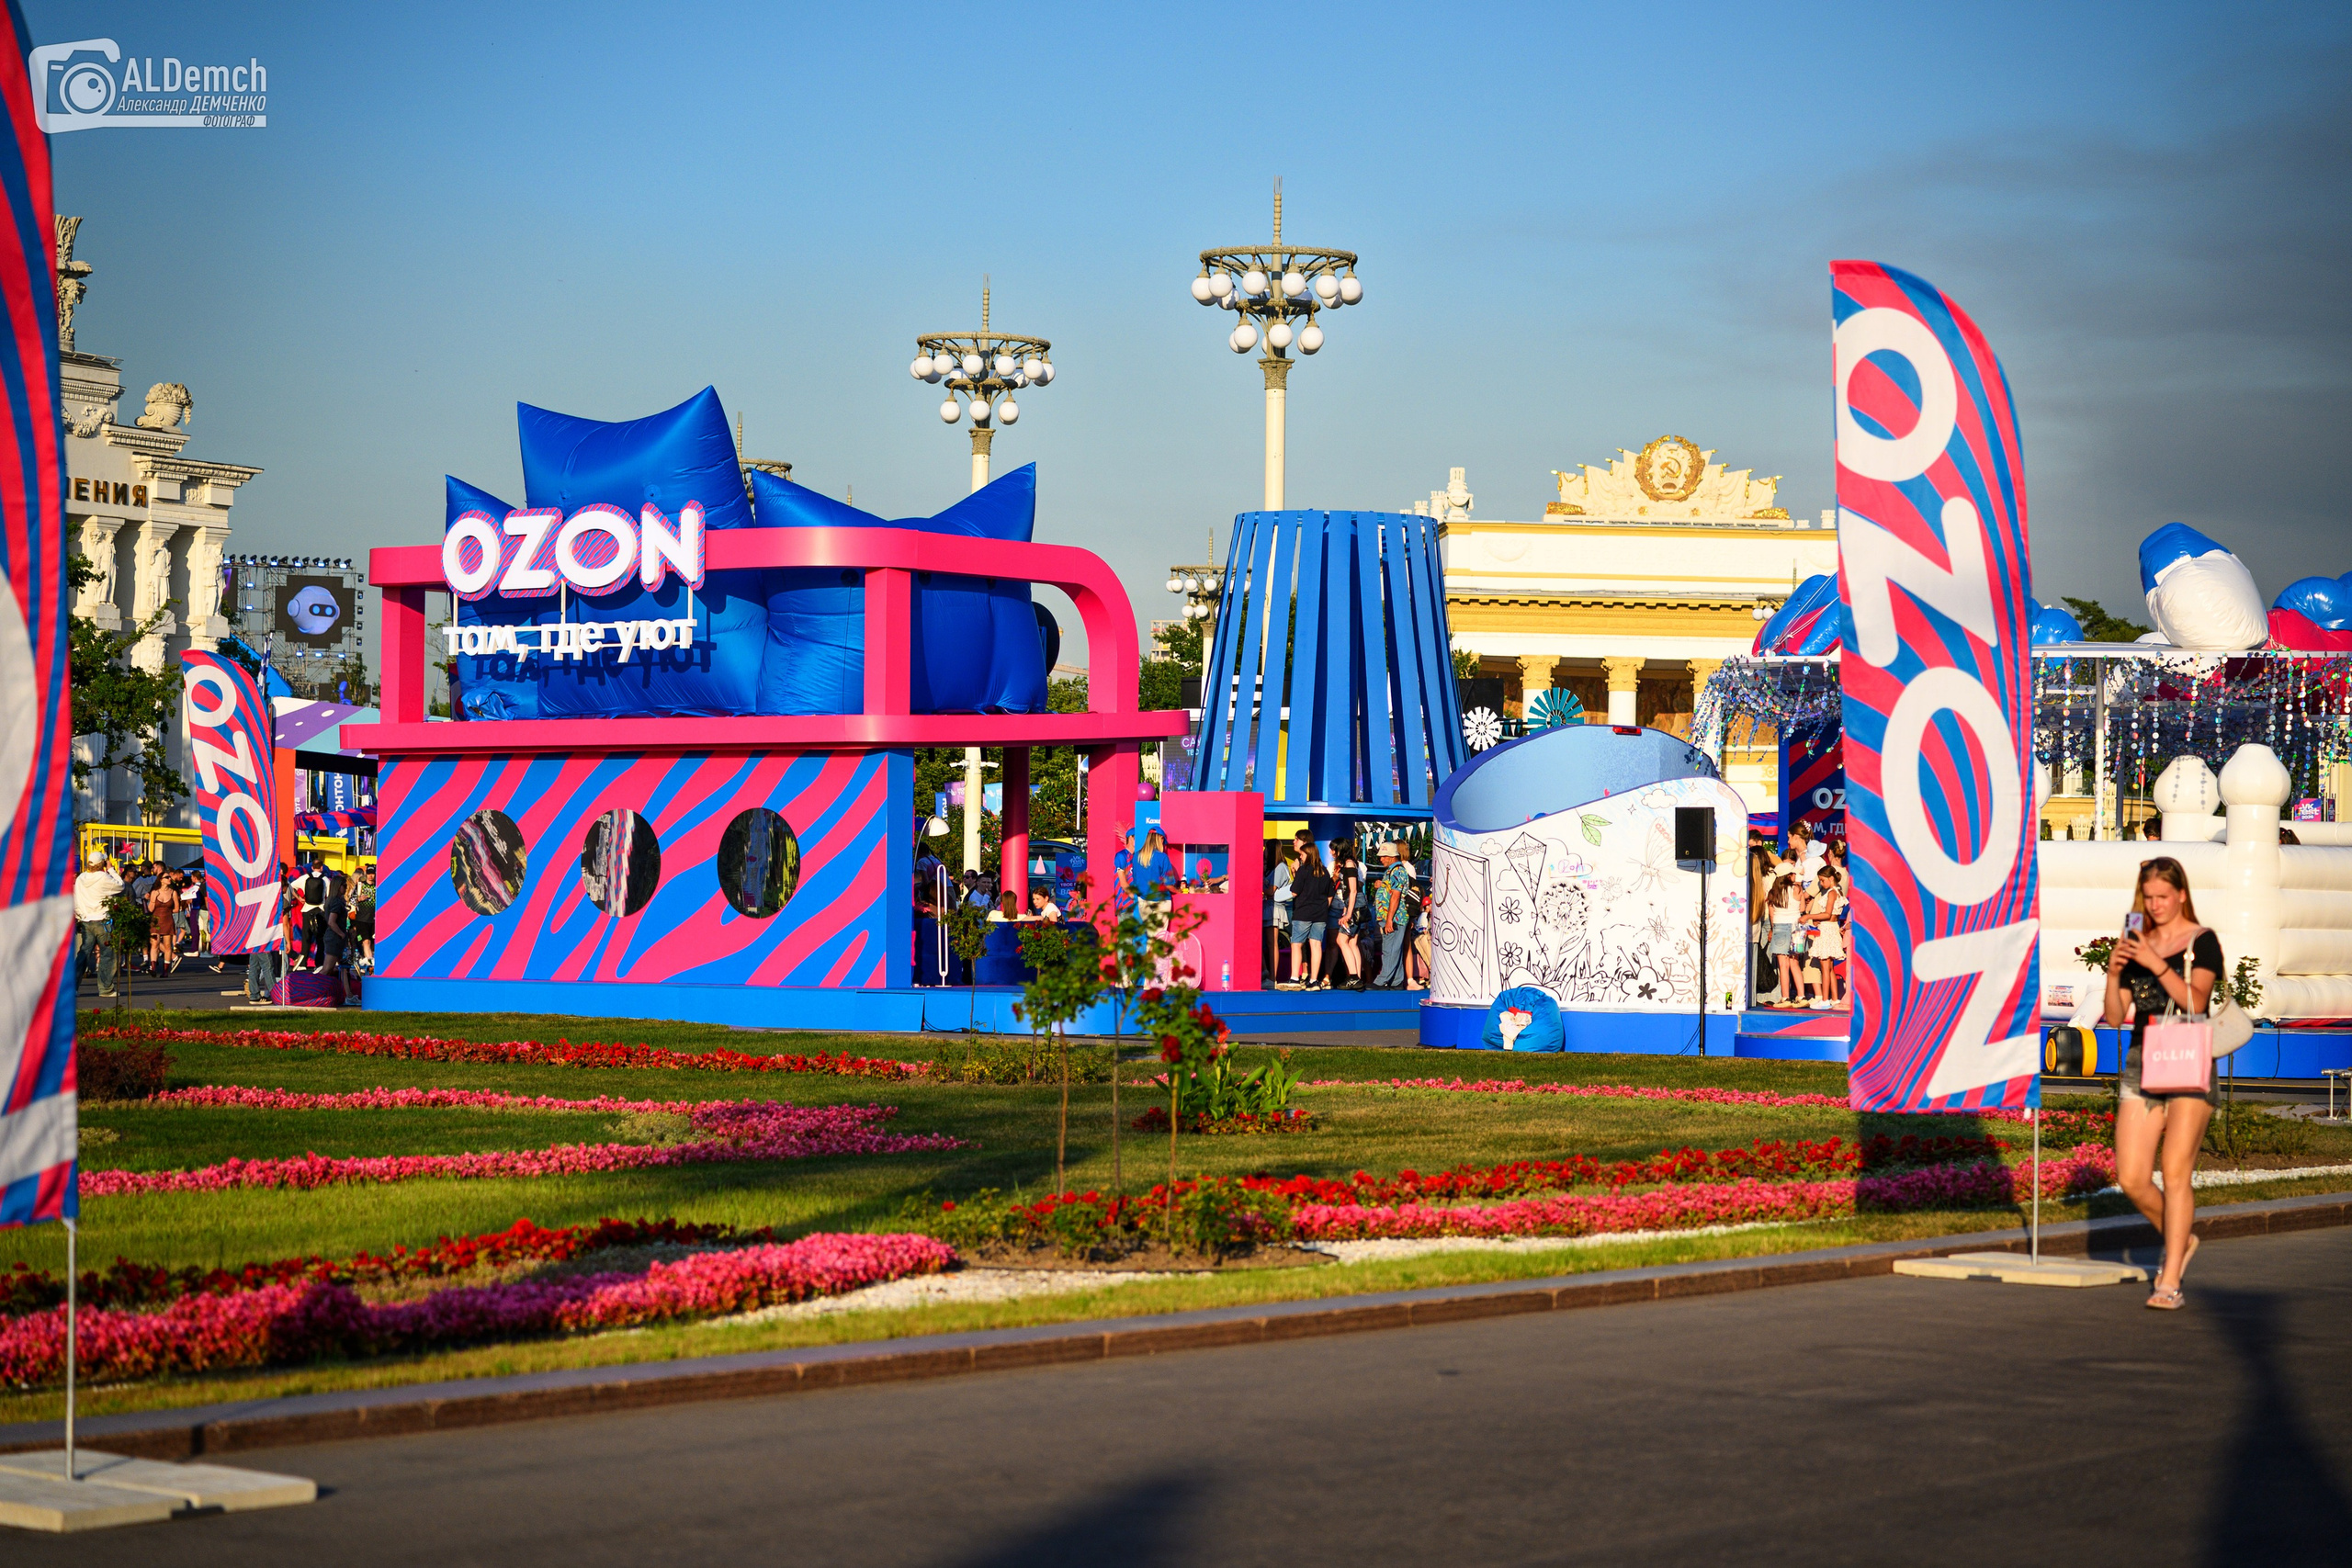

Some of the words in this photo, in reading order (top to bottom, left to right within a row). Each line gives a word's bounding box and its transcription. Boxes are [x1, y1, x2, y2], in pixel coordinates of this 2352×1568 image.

[66, 477, 148, 508] ЕНИЯ
[441, 502, 705, 601] OZON
[443, 625, 528, 662] там,
[540, 621, 605, 660] где
[614, 619, 697, 662] уют
[1837, 307, 2041, 1100] OZON
[185, 665, 284, 950] OZON
[1812, 787, 1847, 809] OZ
[1432, 916, 1479, 958] ZON
[2153, 1049, 2196, 1062] OLLIN
